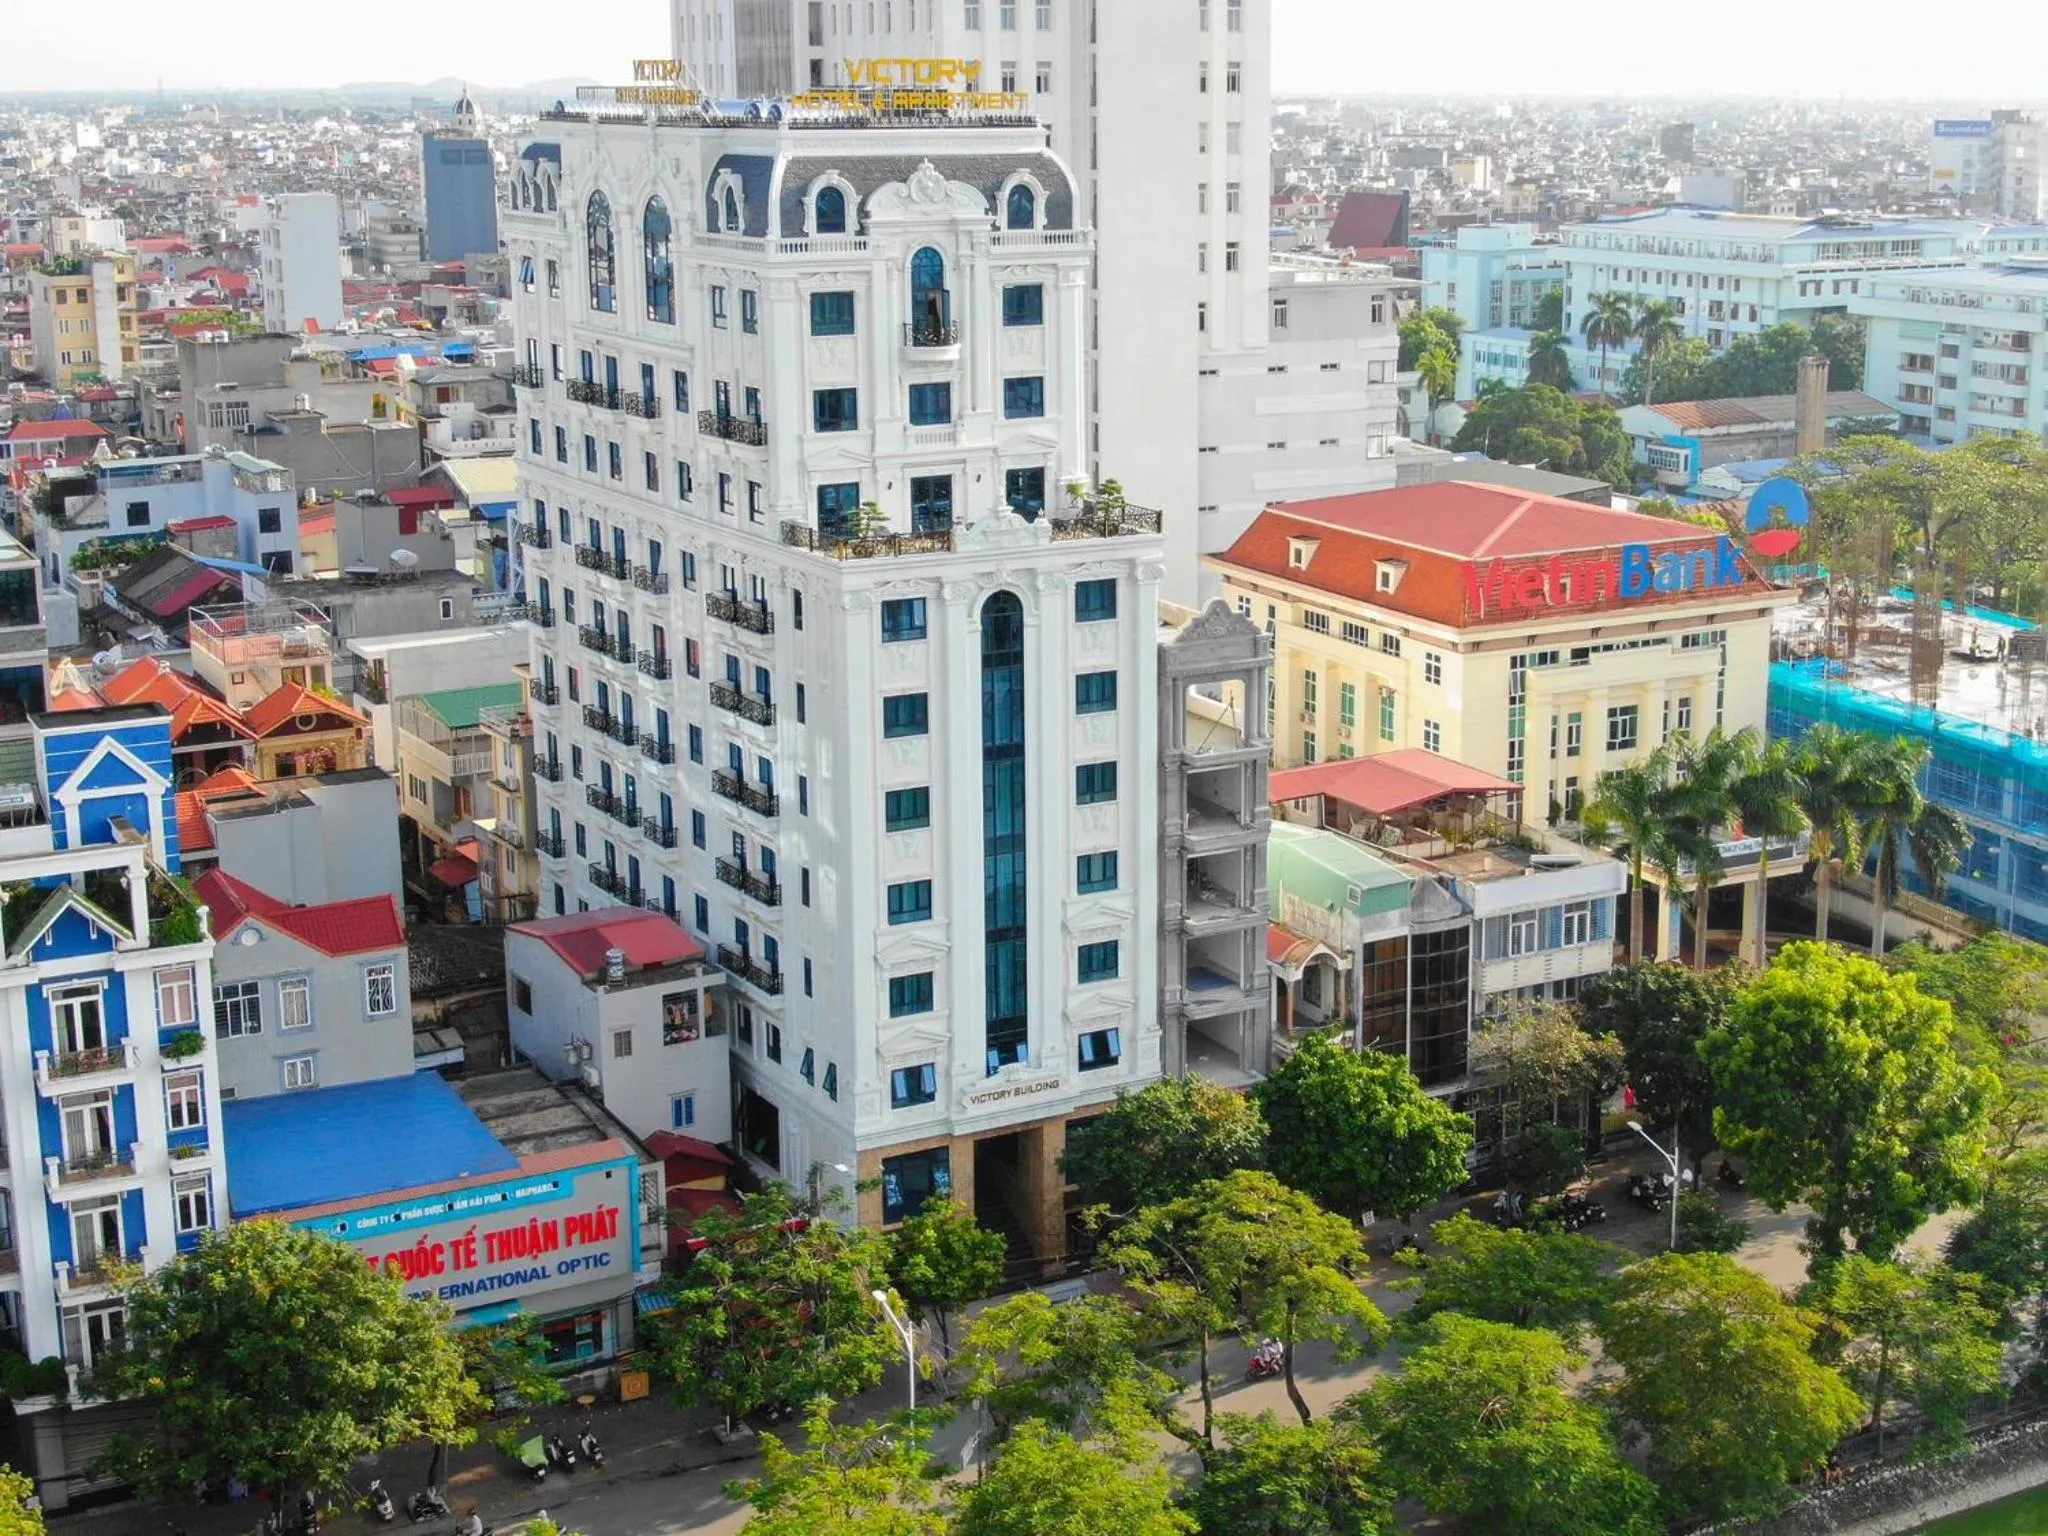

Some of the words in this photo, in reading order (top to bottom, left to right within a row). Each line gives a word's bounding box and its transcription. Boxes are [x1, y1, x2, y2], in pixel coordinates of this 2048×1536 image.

[632, 59, 682, 81] VICTORY
[843, 58, 980, 83] VICTORY
[873, 92, 885, 110] &
[892, 92, 1028, 109] APARTMENT
[1460, 534, 1744, 618] VietinBank
[970, 1089, 1012, 1104] VICTORY
[1014, 1079, 1060, 1097] BUILDING
[450, 1225, 478, 1271] TẾ
[483, 1217, 559, 1263] THUẬN
[564, 1204, 619, 1248] PHÁT
[557, 1252, 612, 1276] OPTIC
